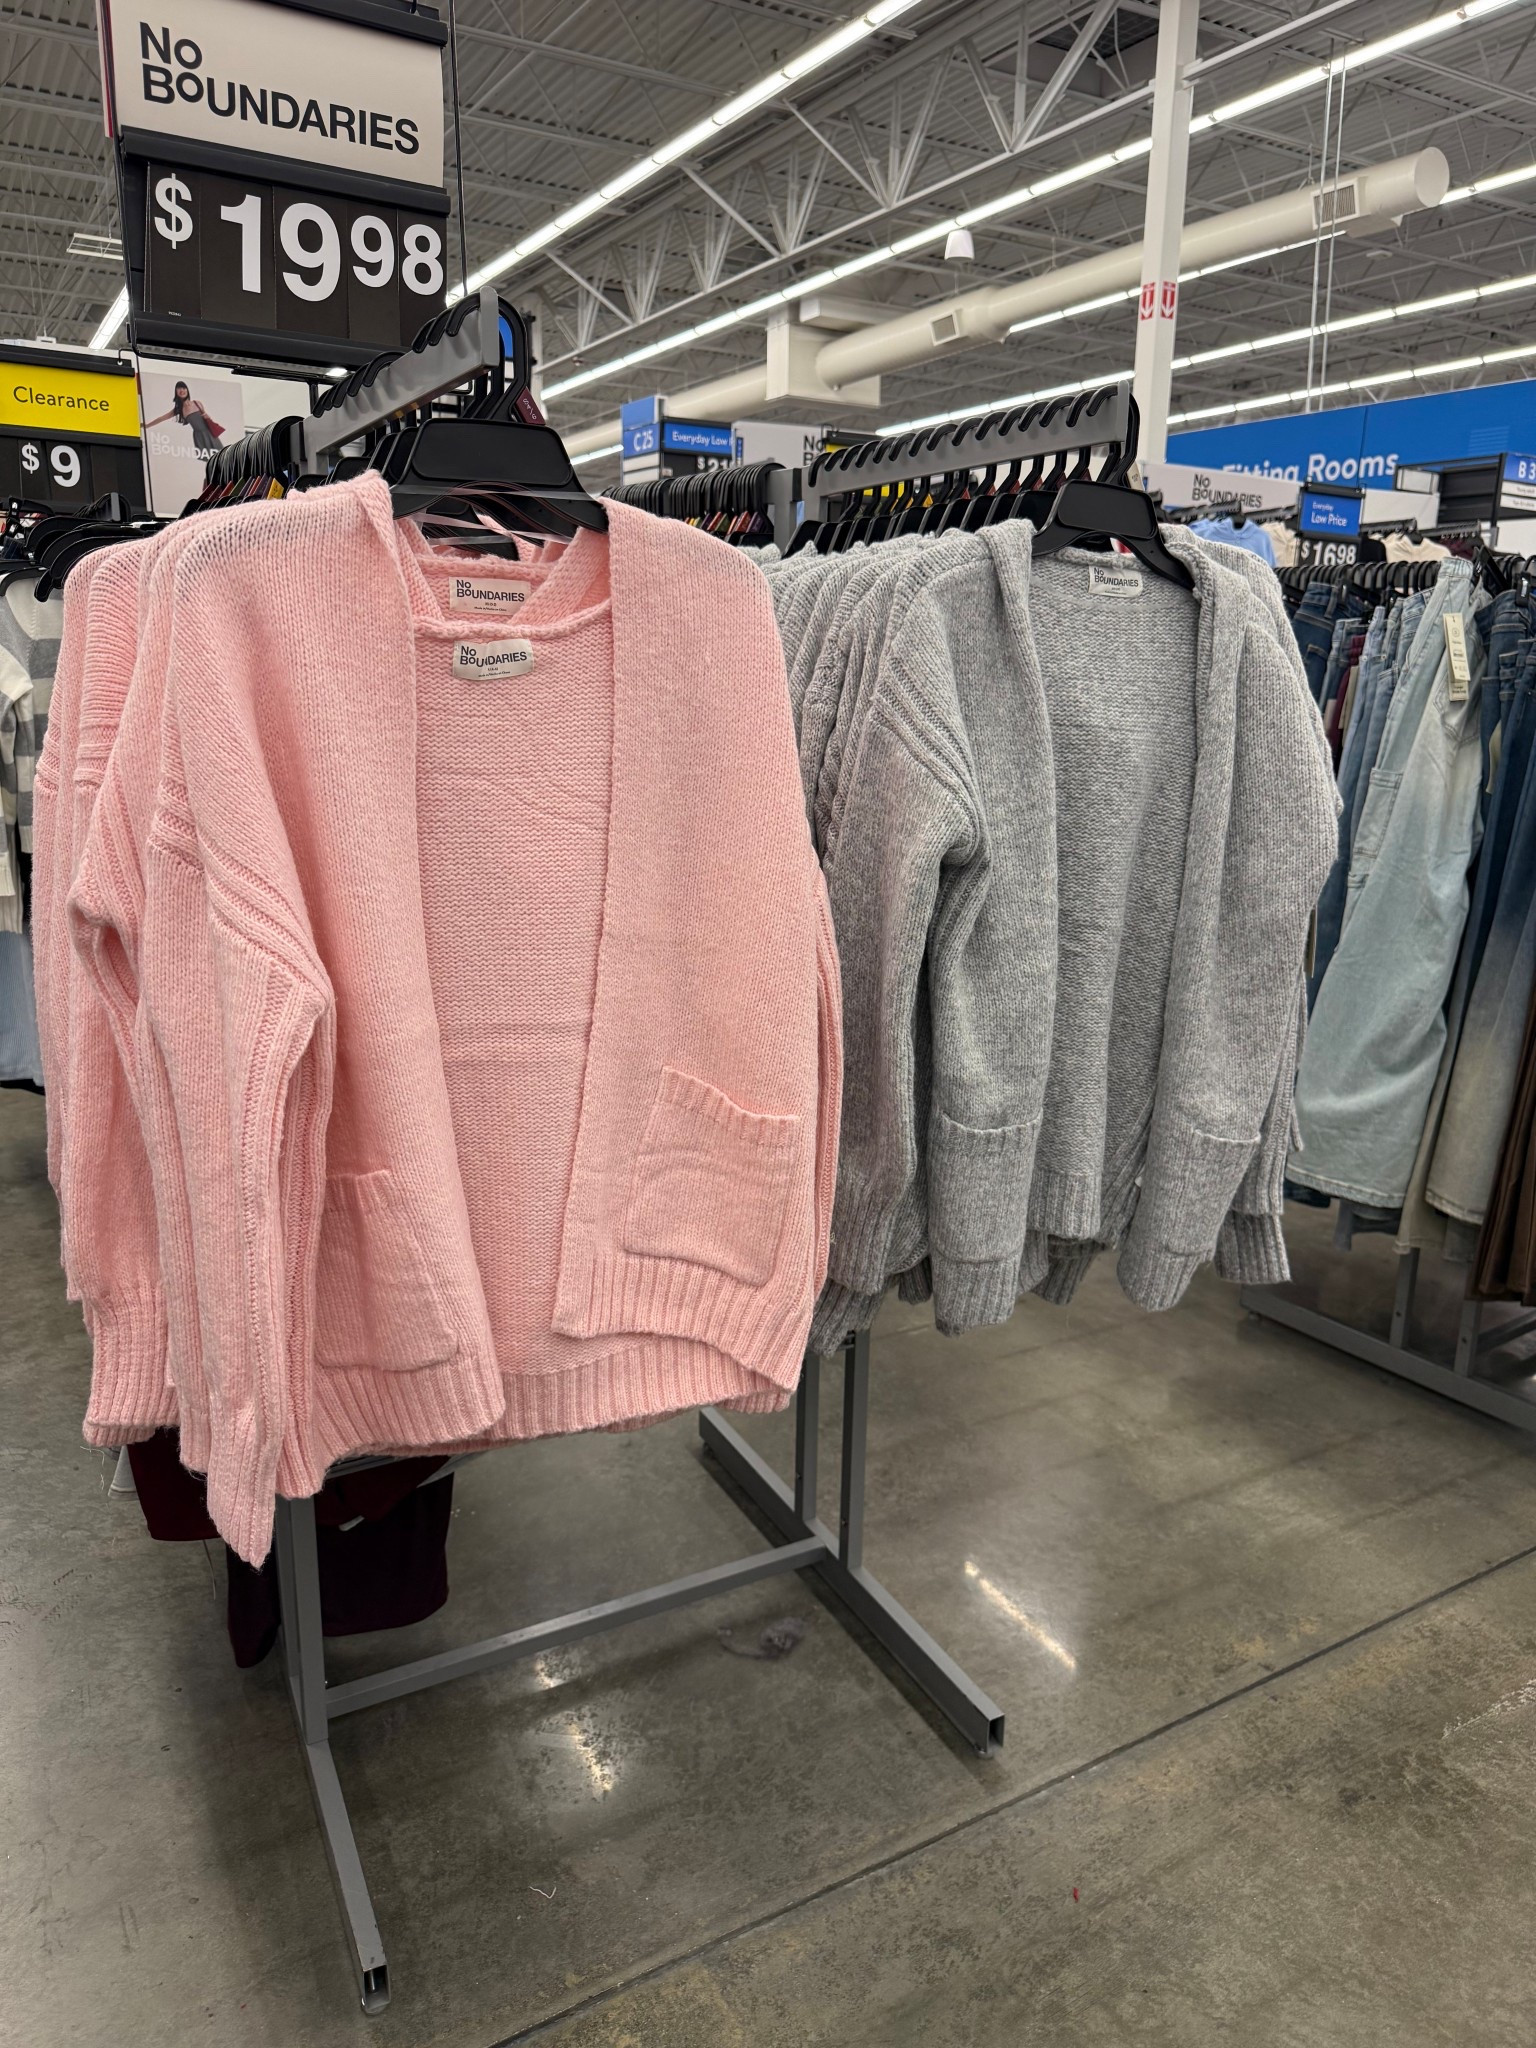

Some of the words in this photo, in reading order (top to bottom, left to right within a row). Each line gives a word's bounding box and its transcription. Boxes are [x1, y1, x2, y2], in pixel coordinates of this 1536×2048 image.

[139, 21, 203, 70] No
[142, 63, 420, 155] BOUNDARIES
[13, 386, 110, 411] Clearance
[672, 431, 709, 446] Everyday
[711, 435, 728, 446] Low
[21, 442, 40, 474] $
[50, 445, 81, 487] 9
[1222, 459, 1299, 482] ting
[1308, 453, 1399, 482] Rooms
[1518, 460, 1527, 479] B
[1193, 474, 1210, 488] No
[1192, 488, 1263, 508] BOUNDARIES
[1311, 511, 1327, 524] Low
[1328, 513, 1347, 527] Price
[1093, 567, 1104, 576] No
[456, 580, 472, 589] No
[456, 588, 525, 602] BOUNDARIES
[461, 645, 477, 657] No
